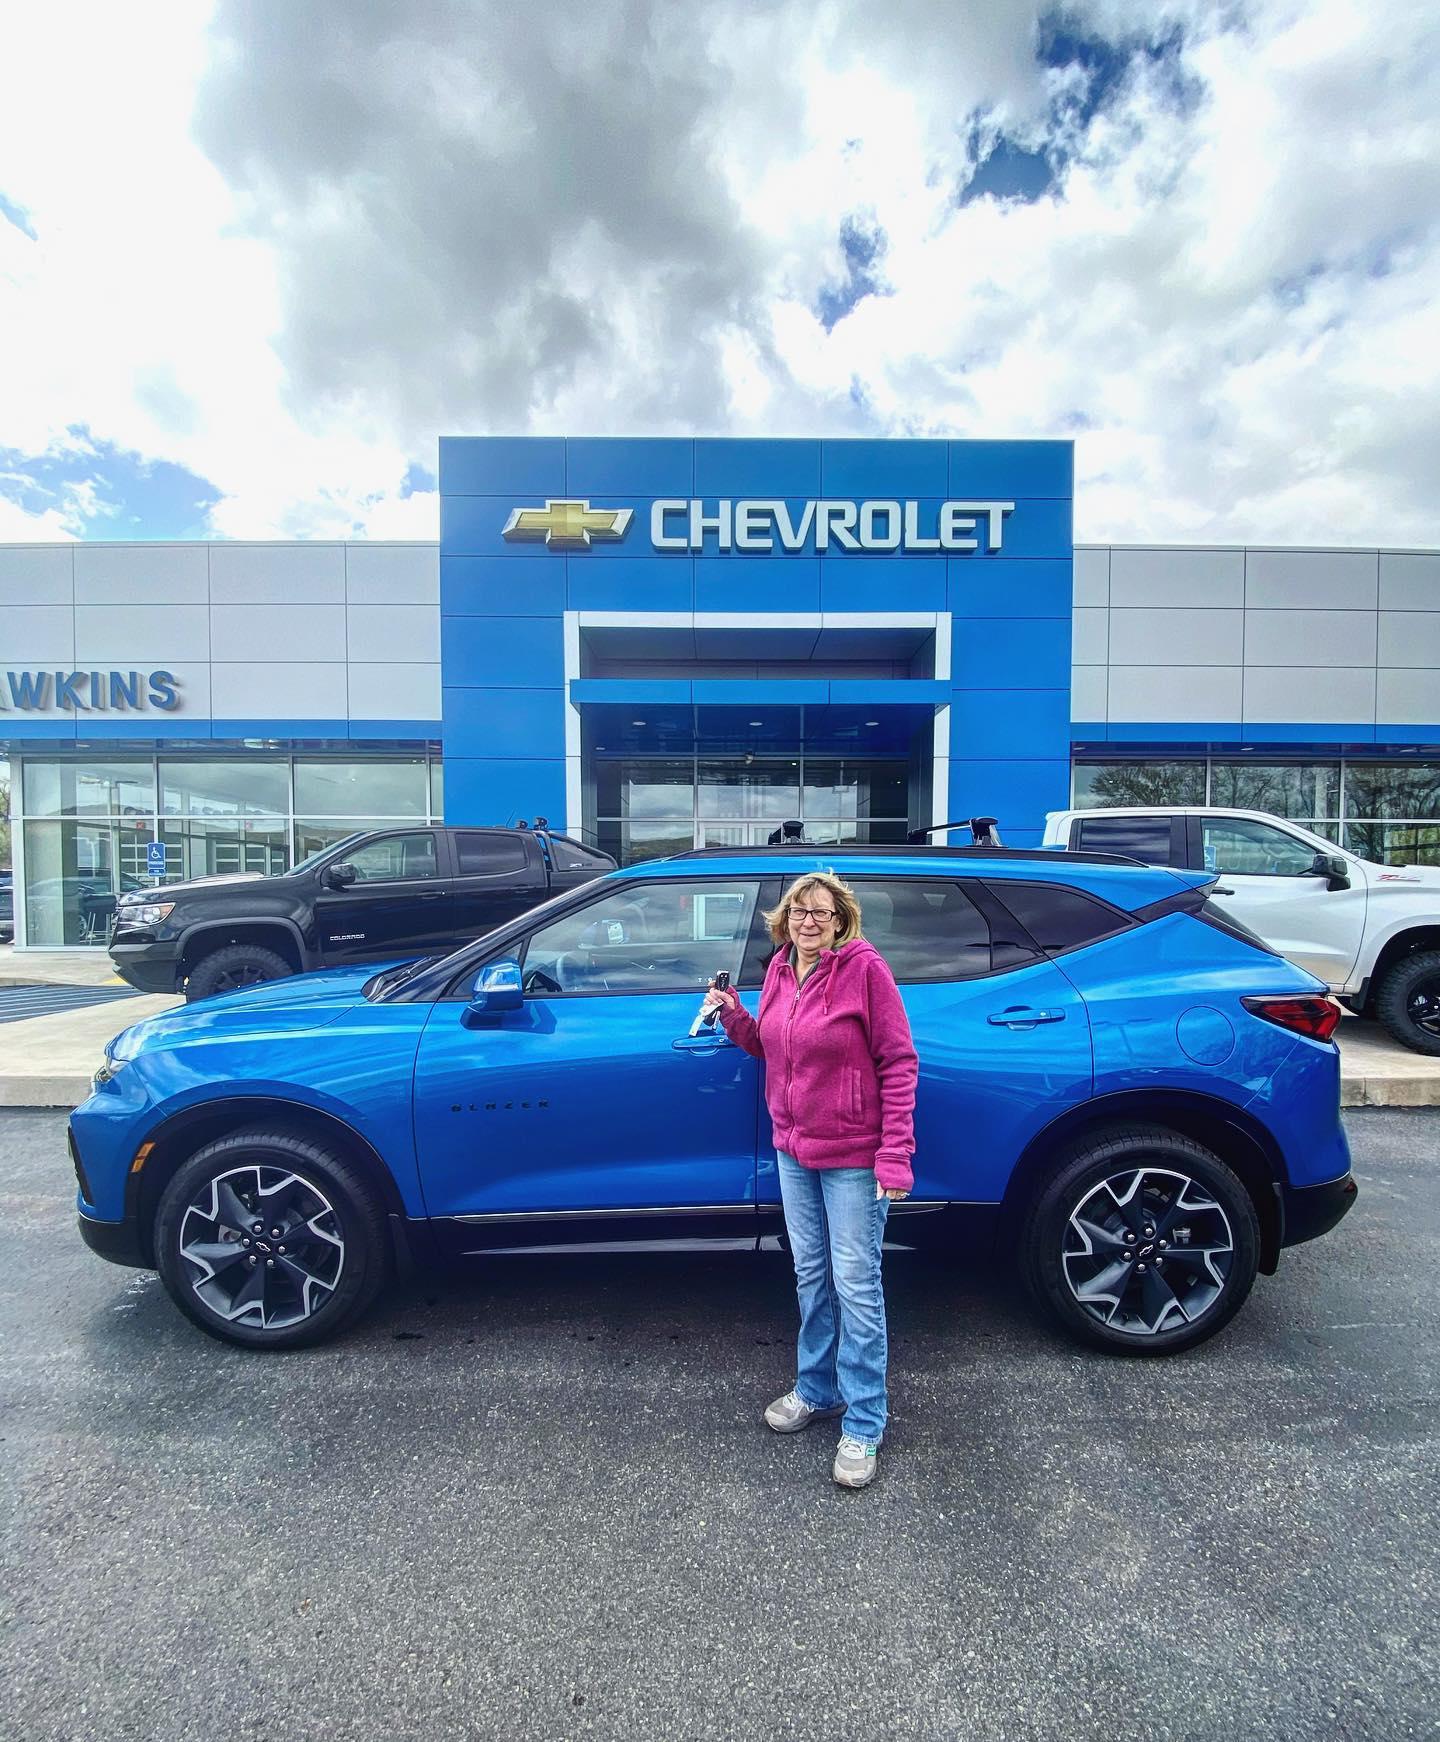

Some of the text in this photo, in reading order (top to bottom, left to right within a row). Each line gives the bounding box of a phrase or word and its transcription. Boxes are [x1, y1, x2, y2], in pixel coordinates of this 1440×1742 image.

[650, 500, 1016, 550] CHEVROLET
[0, 670, 178, 711] WKINS
[451, 1100, 550, 1113] BLAZER
